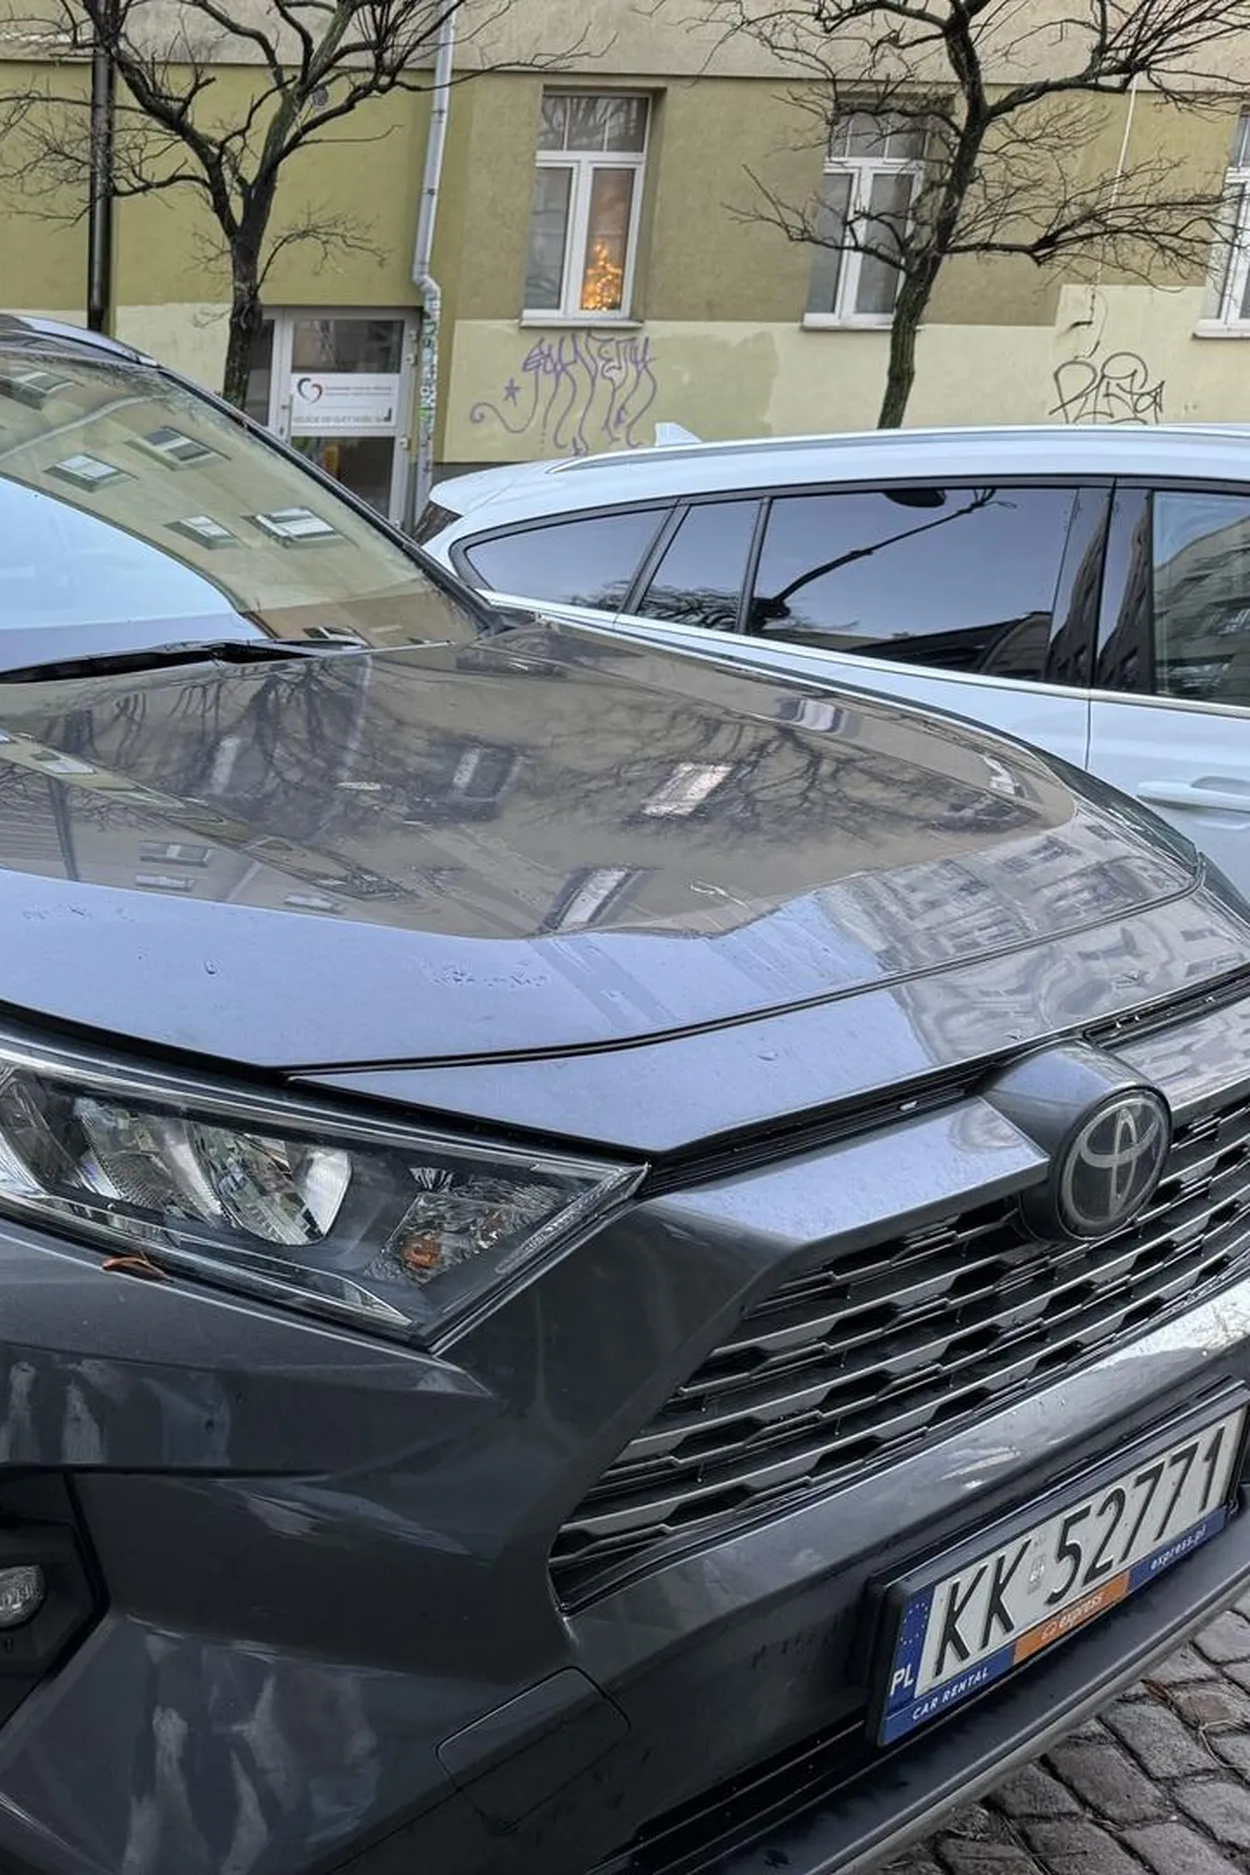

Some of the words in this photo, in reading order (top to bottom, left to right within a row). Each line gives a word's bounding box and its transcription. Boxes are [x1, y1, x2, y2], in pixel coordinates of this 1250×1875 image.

[935, 1539, 1032, 1678] KK
[1044, 1424, 1226, 1606] 52771
[1150, 1523, 1207, 1570] express.pl
[889, 1663, 914, 1697] PL
[912, 1697, 939, 1720] CAR
[942, 1667, 989, 1703] RENTAL
